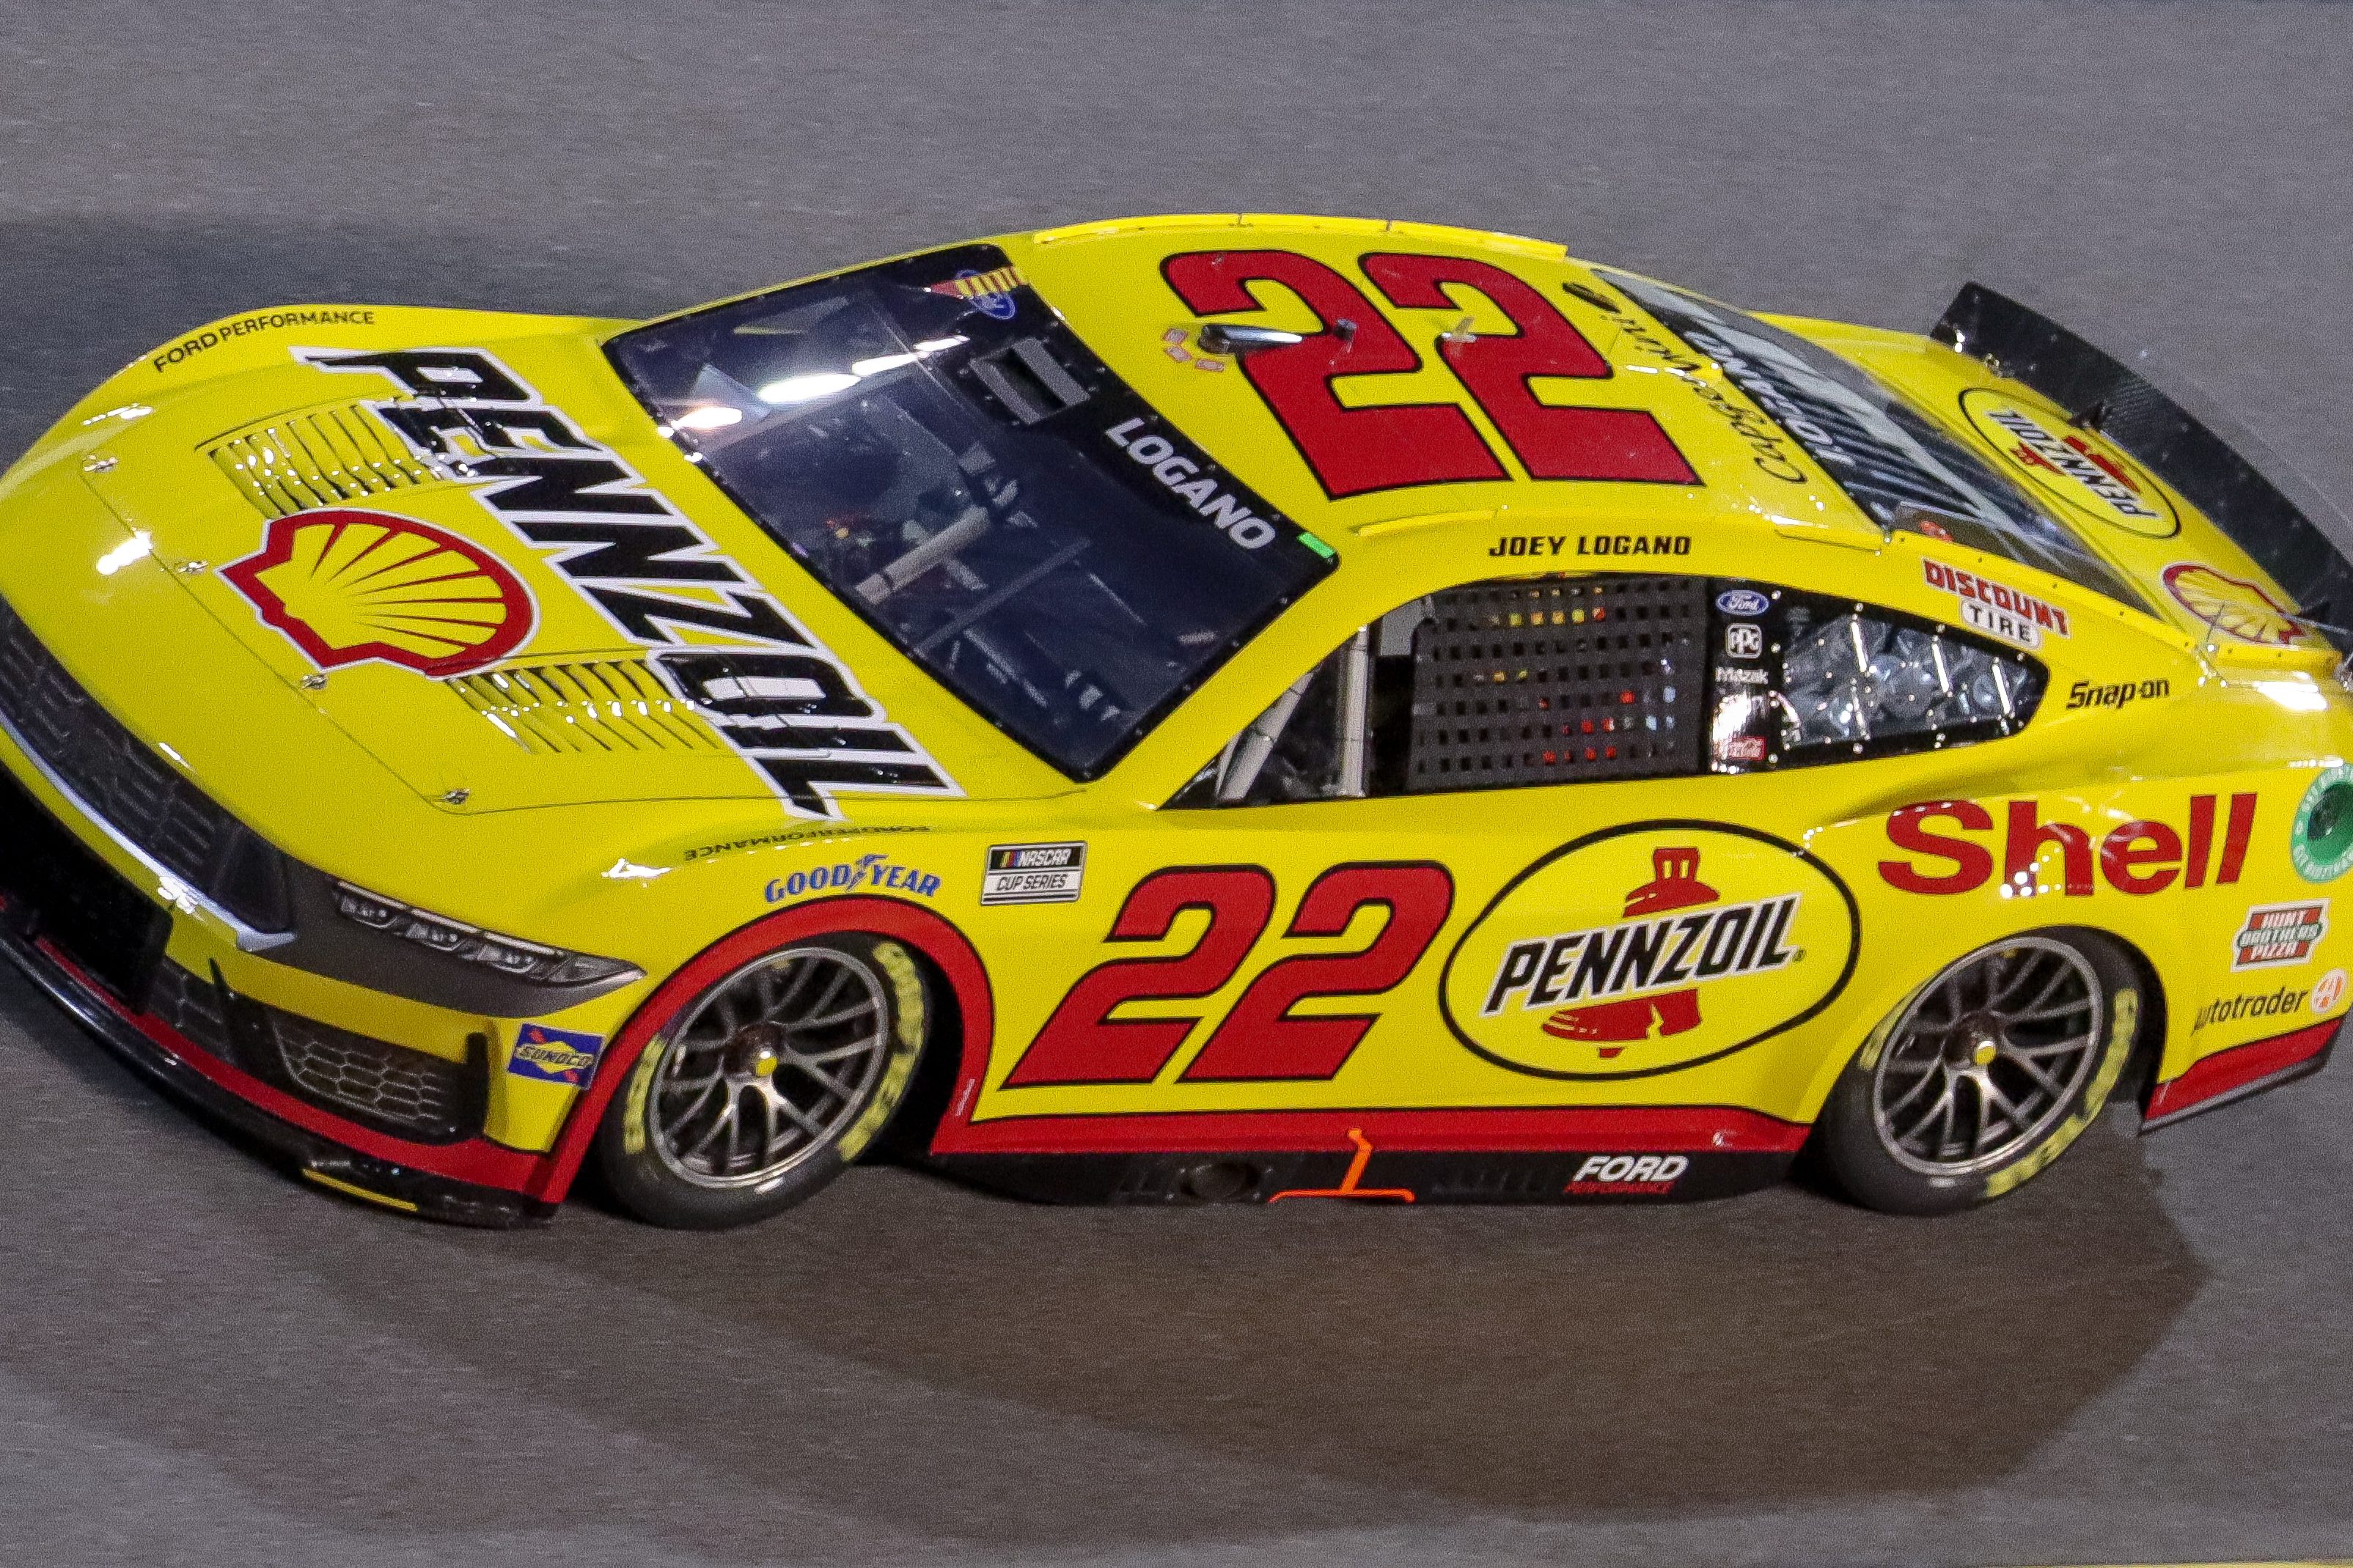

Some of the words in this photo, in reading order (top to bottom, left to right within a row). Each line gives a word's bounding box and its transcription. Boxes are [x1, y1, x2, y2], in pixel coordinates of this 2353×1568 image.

[153, 332, 219, 373] FORD
[220, 310, 375, 342] PERFORMANCE
[1159, 249, 1706, 500] 22
[1984, 410, 2162, 519] PENNZOIL
[1105, 417, 1276, 551] LOGANO
[1488, 536, 1566, 556] JOEY
[1576, 536, 1692, 556] LOGANO
[288, 347, 968, 821] PENNZOIL
[1923, 559, 2070, 636] DISCOUNT
[1729, 627, 1760, 655] PPG
[1968, 603, 2033, 643] TIRE
[2066, 677, 2170, 710] Snap-on
[1017, 848, 1072, 867] NASCAR
[1879, 792, 2258, 897] Shell
[996, 875, 1024, 891] CUP
[1024, 873, 1068, 888] SERIES
[2239, 924, 2319, 947] BROTHERS
[2261, 910, 2308, 929] HUNT
[1481, 892, 1804, 1017] PENNZOIL
[2250, 941, 2299, 960] PIZZA
[999, 861, 1454, 1091] 22
[516, 1045, 592, 1068] SUNOCO
[1572, 1155, 1689, 1182] FORD
